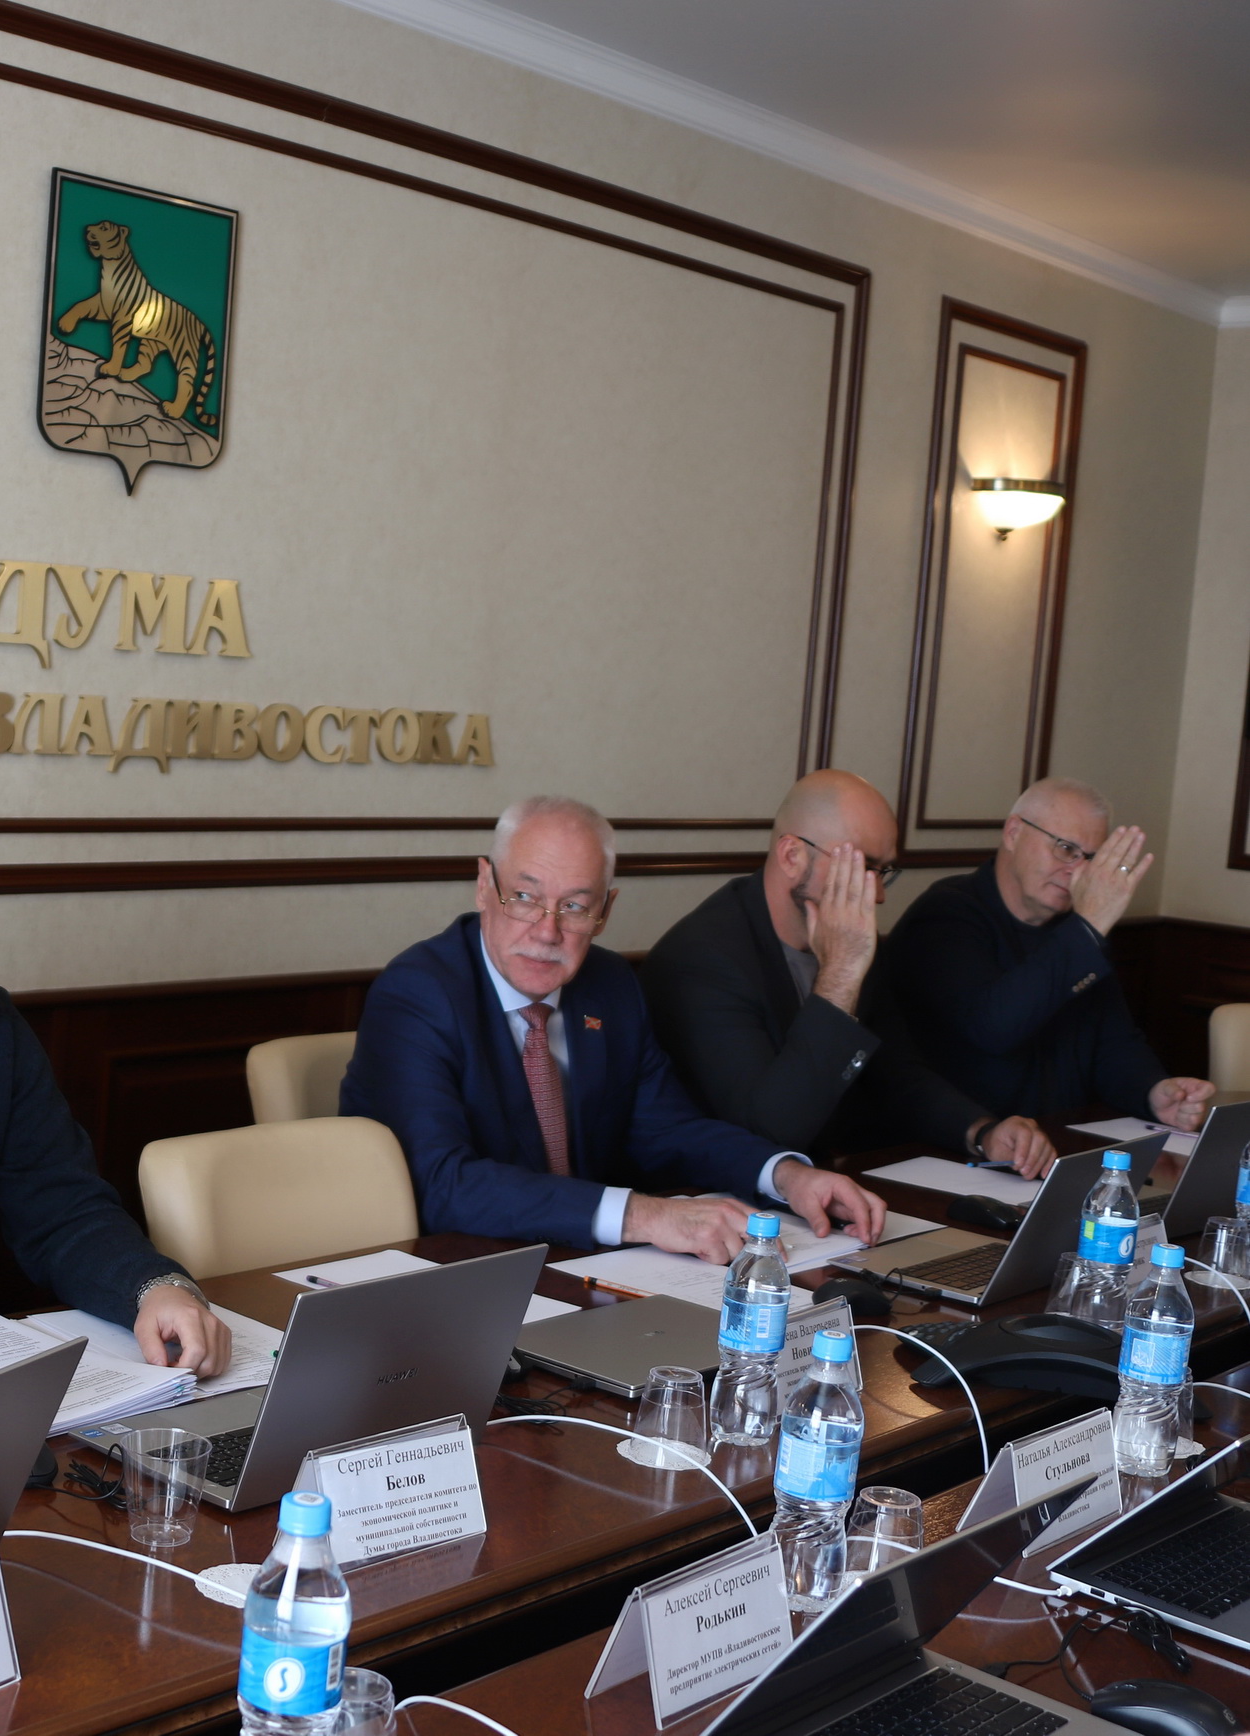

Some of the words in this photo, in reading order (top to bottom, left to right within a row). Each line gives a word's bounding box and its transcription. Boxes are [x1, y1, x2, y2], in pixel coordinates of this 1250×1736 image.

[337, 1452, 384, 1476] Сергей
[386, 1440, 465, 1465] Геннадьевич
[1017, 1447, 1051, 1469] Наталья
[1052, 1420, 1111, 1456] Александровна
[386, 1472, 426, 1491] Белов
[1045, 1452, 1091, 1481] Стульнова
[337, 1502, 384, 1519] Заместитель
[384, 1491, 433, 1510] председателя
[434, 1486, 468, 1499] комитета
[468, 1482, 477, 1491] по
[360, 1508, 417, 1527] экономической
[418, 1503, 452, 1517] политике
[355, 1523, 414, 1543] муниципальной
[415, 1511, 467, 1530] собственности
[363, 1544, 386, 1557] Думы
[386, 1538, 412, 1552] города
[413, 1526, 463, 1544] Владивостока
[664, 1583, 712, 1617] Алексей
[713, 1565, 771, 1595] Сергеевич
[695, 1602, 747, 1633] Родькин
[666, 1660, 700, 1682] Директор
[700, 1648, 723, 1665] МУПВ
[724, 1625, 781, 1654] «Владивостокское
[669, 1671, 713, 1694] предприятие
[713, 1649, 761, 1676] электрических
[761, 1640, 782, 1654] сетей»
